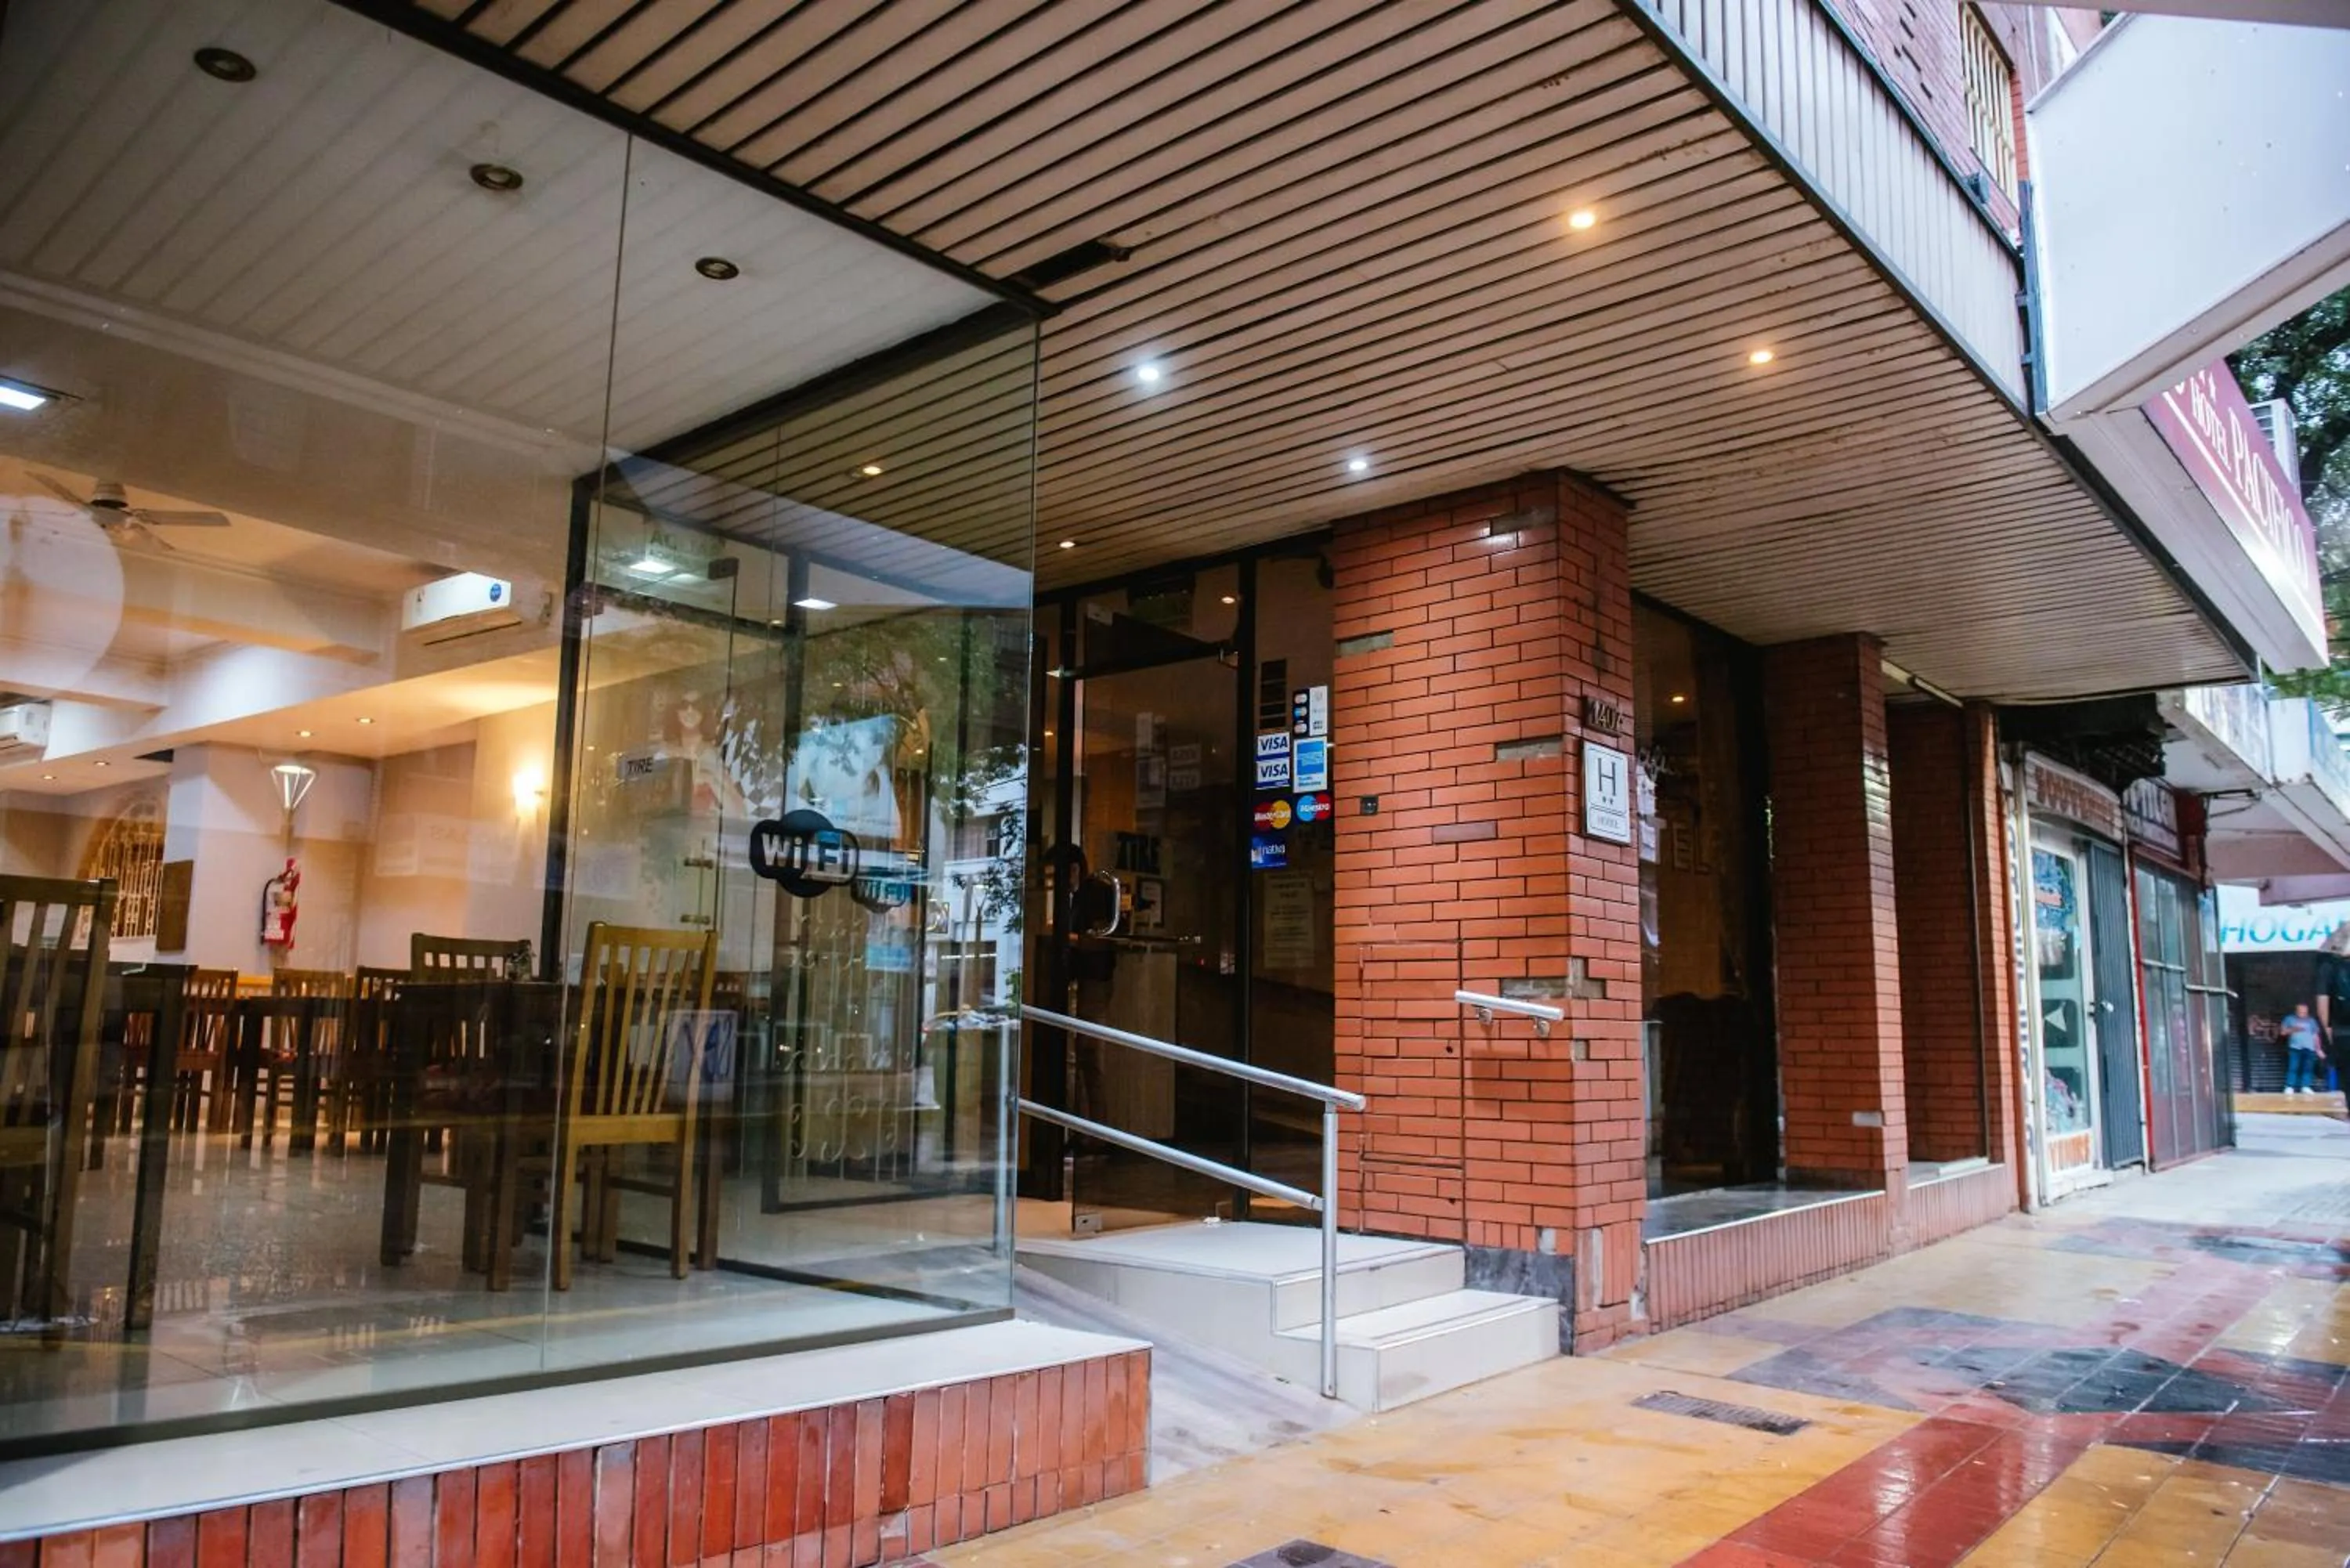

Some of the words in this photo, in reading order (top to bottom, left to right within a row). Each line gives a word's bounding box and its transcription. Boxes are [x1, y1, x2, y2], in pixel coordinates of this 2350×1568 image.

[2190, 376, 2232, 473] HOTEL
[1260, 735, 1288, 752] VISA
[627, 756, 653, 775] TIRE
[1260, 763, 1288, 778] VISA
[1597, 757, 1616, 797] H
[761, 832, 849, 875] WiFi
